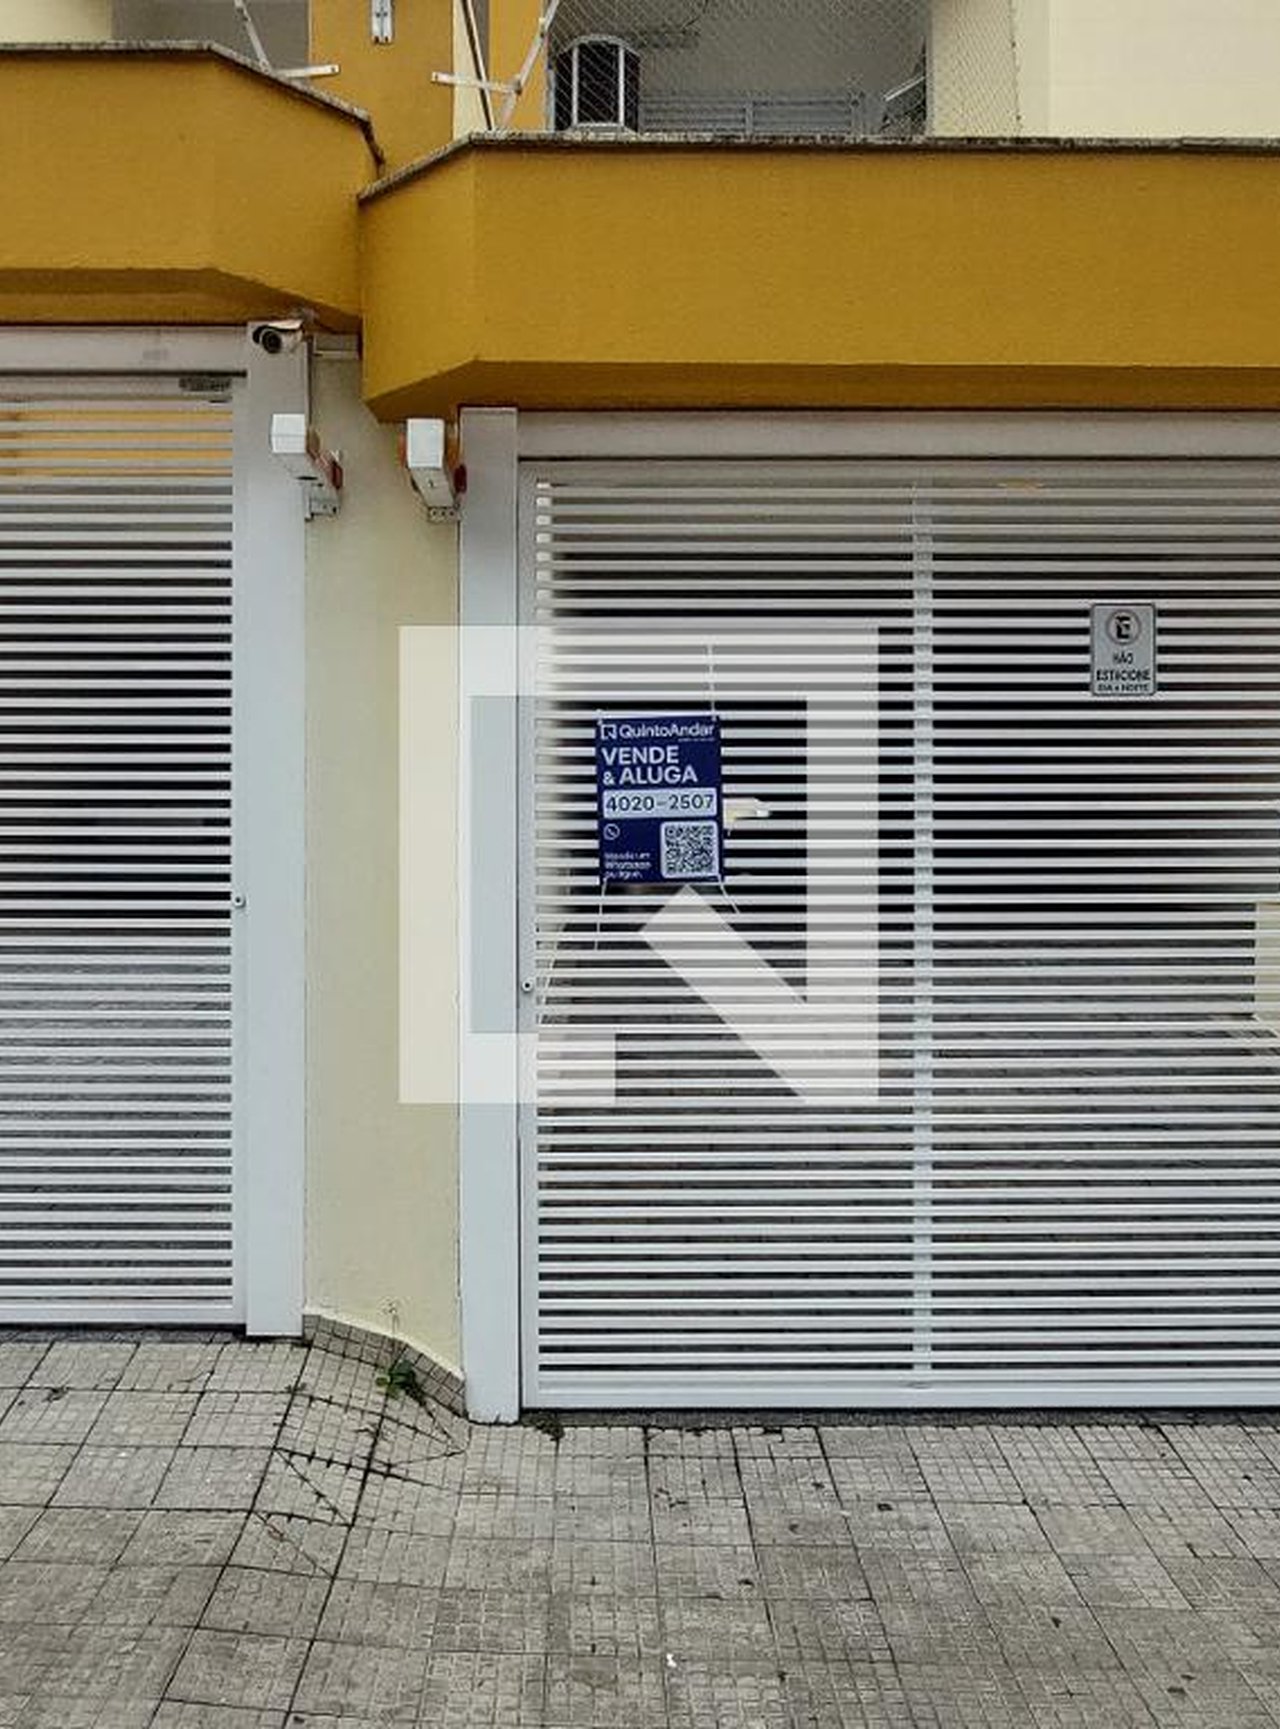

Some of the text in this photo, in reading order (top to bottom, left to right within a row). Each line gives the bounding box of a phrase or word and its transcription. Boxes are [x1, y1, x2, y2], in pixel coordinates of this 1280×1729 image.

[1112, 651, 1133, 665] NÃO
[619, 722, 715, 739] QuintoAndar
[601, 745, 680, 766] VENDE
[602, 765, 699, 786] & ALUGA
